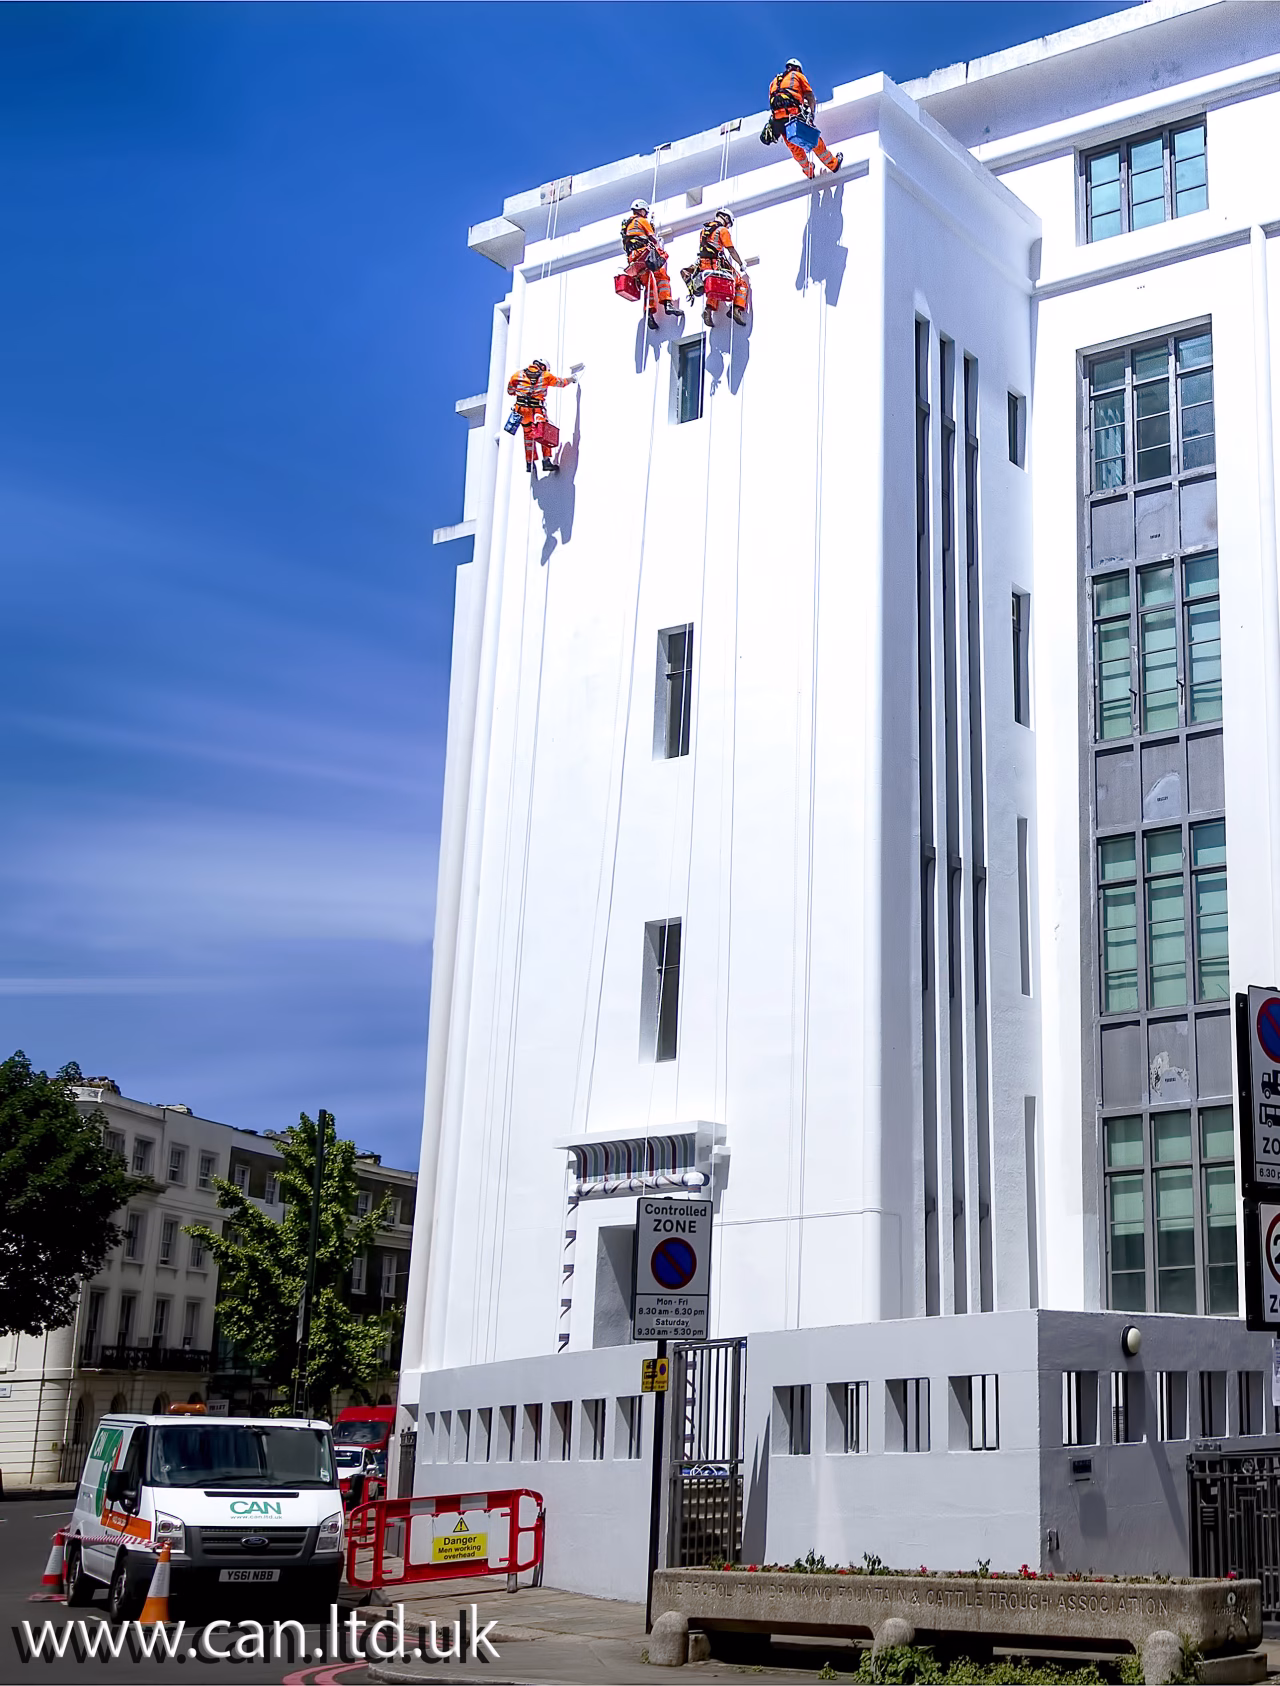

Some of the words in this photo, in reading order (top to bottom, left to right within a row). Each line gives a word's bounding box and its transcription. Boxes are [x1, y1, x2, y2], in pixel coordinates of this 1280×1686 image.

[1259, 1167, 1276, 1179] 6.30
[644, 1203, 707, 1217] Controlled
[653, 1218, 697, 1234] ZONE
[656, 1298, 673, 1306] Mon
[678, 1298, 689, 1306] Fri
[638, 1307, 657, 1316] 8.30
[658, 1308, 669, 1316] am
[674, 1307, 693, 1316] 6.30
[693, 1309, 705, 1317] pm
[655, 1318, 690, 1328] Saturday
[637, 1327, 656, 1336] 9.30
[673, 1328, 692, 1336] 5.30
[230, 1500, 282, 1515] CAN
[443, 1536, 477, 1546] Danger
[453, 1544, 482, 1552] working
[443, 1551, 476, 1560] overhead
[227, 1570, 251, 1581] YS61
[664, 1580, 764, 1599] METROPOLITAN
[769, 1584, 832, 1603] DRINKING
[838, 1586, 907, 1606] FOUNTAIN
[911, 1591, 921, 1606] &
[926, 1590, 984, 1609] CATTLE
[988, 1592, 1050, 1612] TROUGH
[1058, 1594, 1170, 1618] ASSOCIATION
